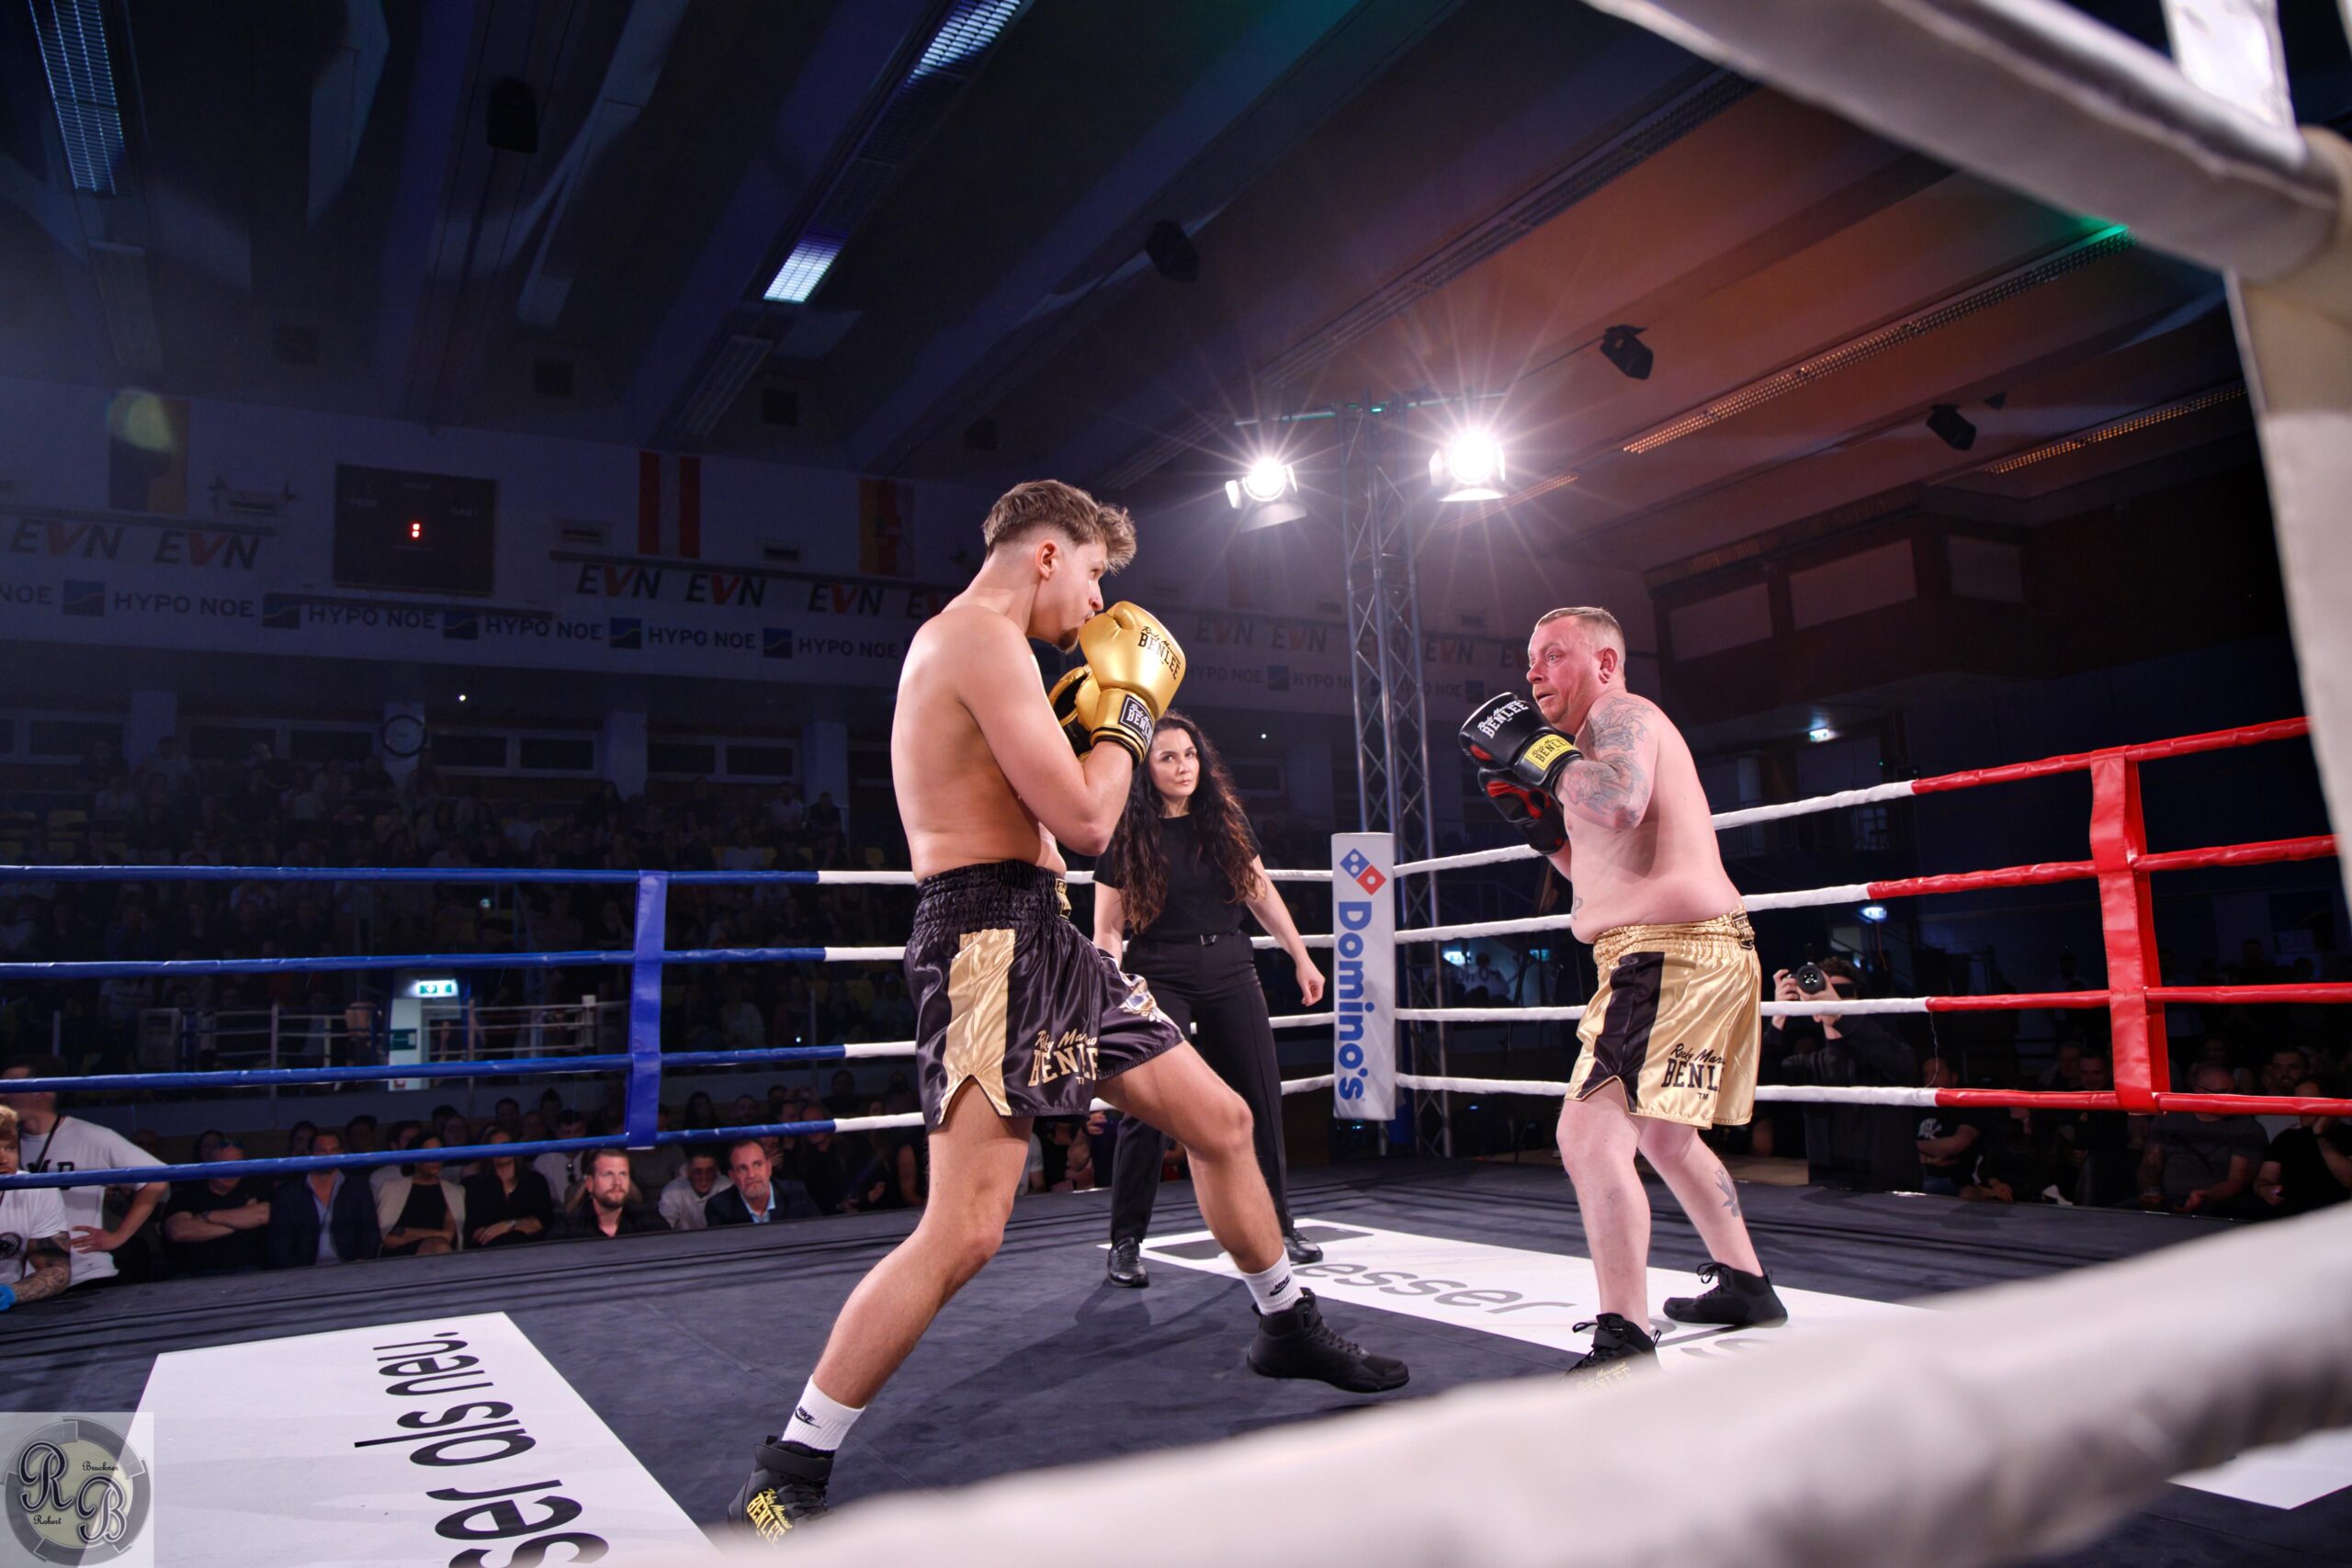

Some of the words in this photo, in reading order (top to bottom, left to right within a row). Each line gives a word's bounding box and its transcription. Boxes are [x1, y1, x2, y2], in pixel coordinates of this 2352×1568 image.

[9, 517, 126, 560] EVN
[153, 529, 260, 570] EVN
[114, 592, 191, 615] HYPO
[199, 597, 254, 619] NOE
[577, 563, 662, 599] EVN
[686, 572, 766, 608] EVN
[808, 582, 884, 616] EVN
[905, 590, 956, 620] EV
[308, 604, 378, 626] HYPO
[387, 610, 436, 631] NOE
[486, 616, 549, 638] HYPO
[557, 622, 603, 641] NOE
[648, 626, 707, 648] HYPO
[715, 630, 756, 649] NOE
[798, 637, 854, 656] HYPO
[860, 640, 899, 659] NOE
[1339, 901, 1374, 1100] Domino's
[372, 1332, 494, 1396] neu.
[354, 1401, 537, 1466] als
